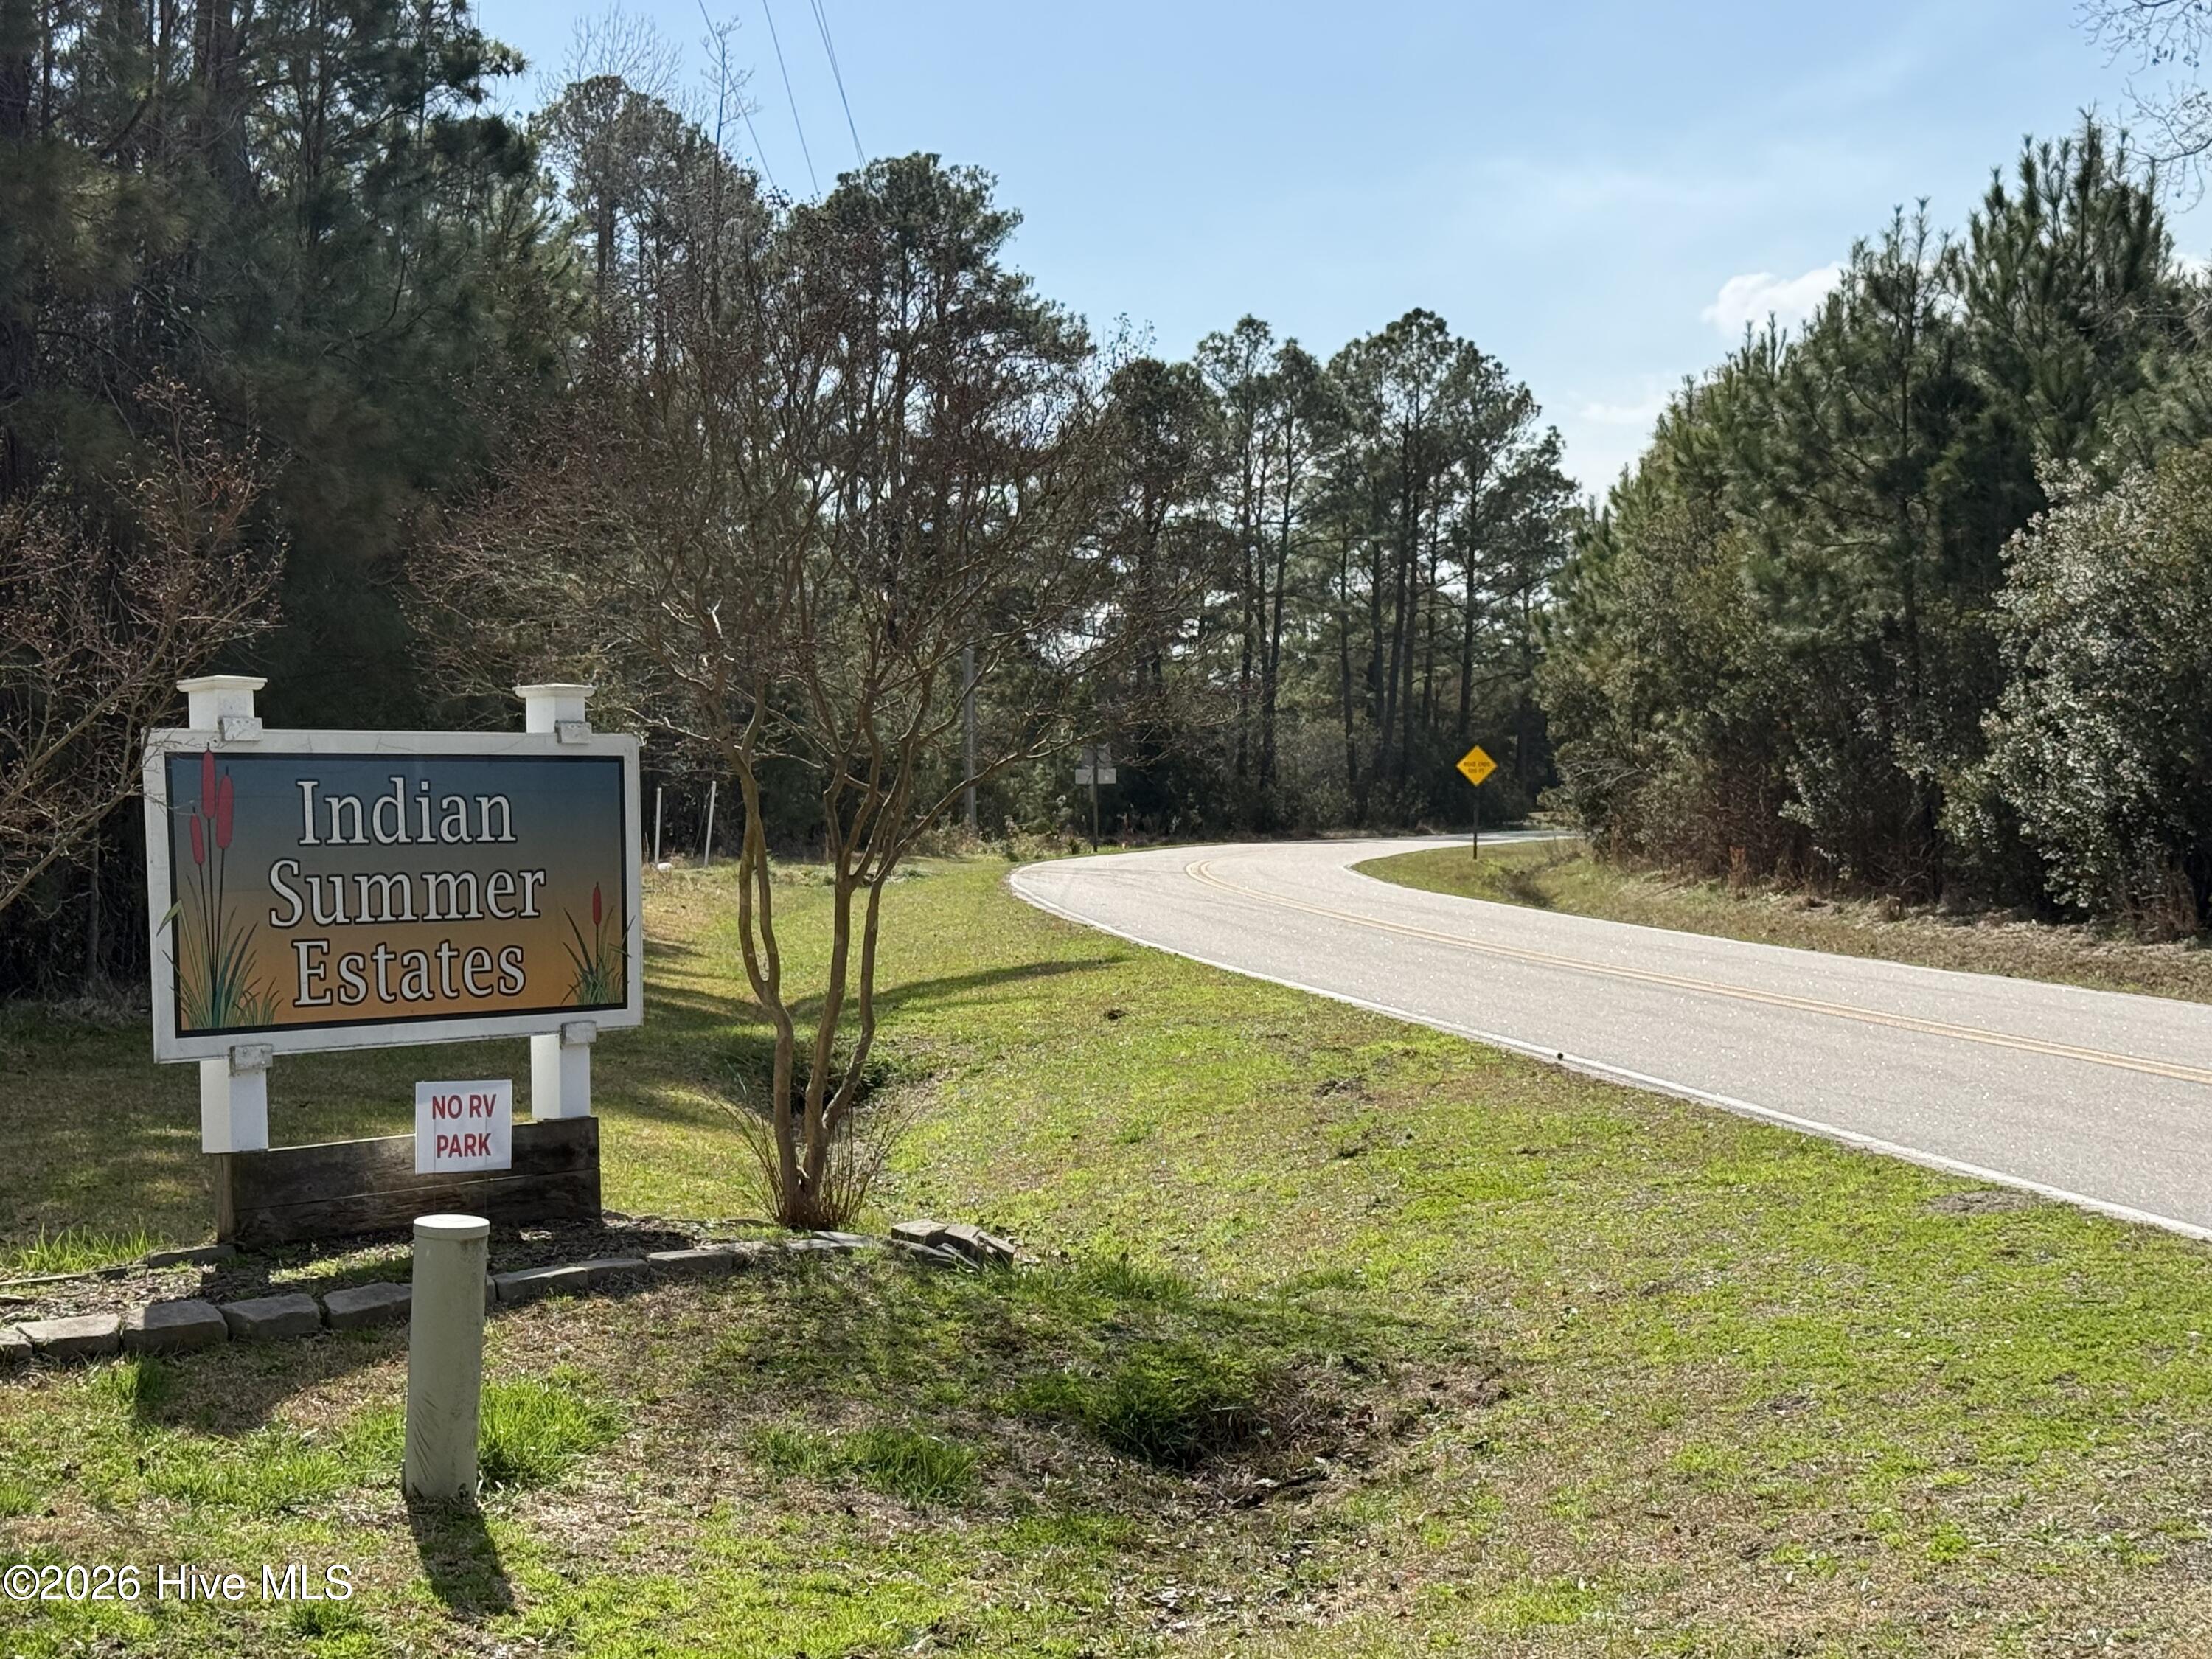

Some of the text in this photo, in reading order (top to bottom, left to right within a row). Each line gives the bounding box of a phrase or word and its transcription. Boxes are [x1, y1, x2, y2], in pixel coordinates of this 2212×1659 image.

[296, 776, 518, 846] Indian
[269, 859, 547, 928] Summer
[293, 939, 526, 1007] Estates
[432, 1093, 497, 1119] NO RV
[437, 1133, 492, 1158] PARK
